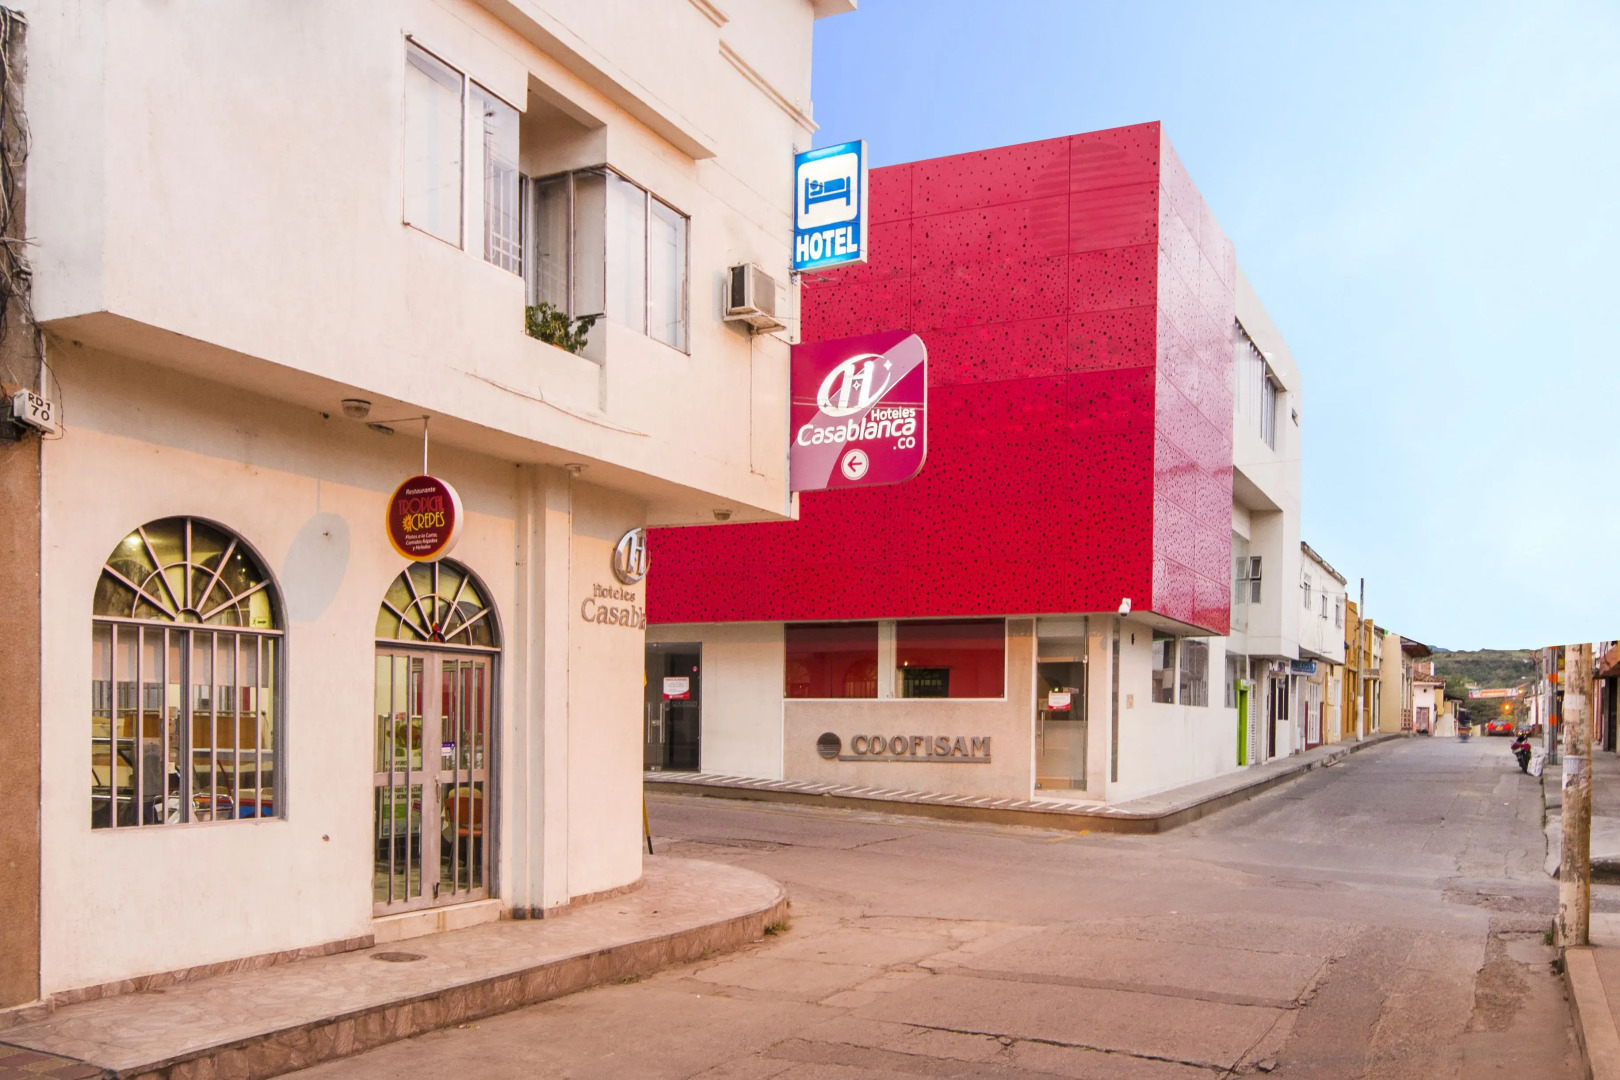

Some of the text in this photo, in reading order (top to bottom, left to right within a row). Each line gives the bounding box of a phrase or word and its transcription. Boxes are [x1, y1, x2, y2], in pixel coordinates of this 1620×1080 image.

[796, 226, 858, 262] HOTEL
[31, 404, 50, 421] 70
[871, 407, 916, 421] Hoteles
[797, 418, 916, 446] Casablanca
[405, 487, 436, 495] Restaurante
[398, 496, 444, 514] TROPICAL
[411, 511, 445, 531] CREPES
[593, 583, 636, 602] Hoteles
[851, 734, 992, 757] COOFISAM
